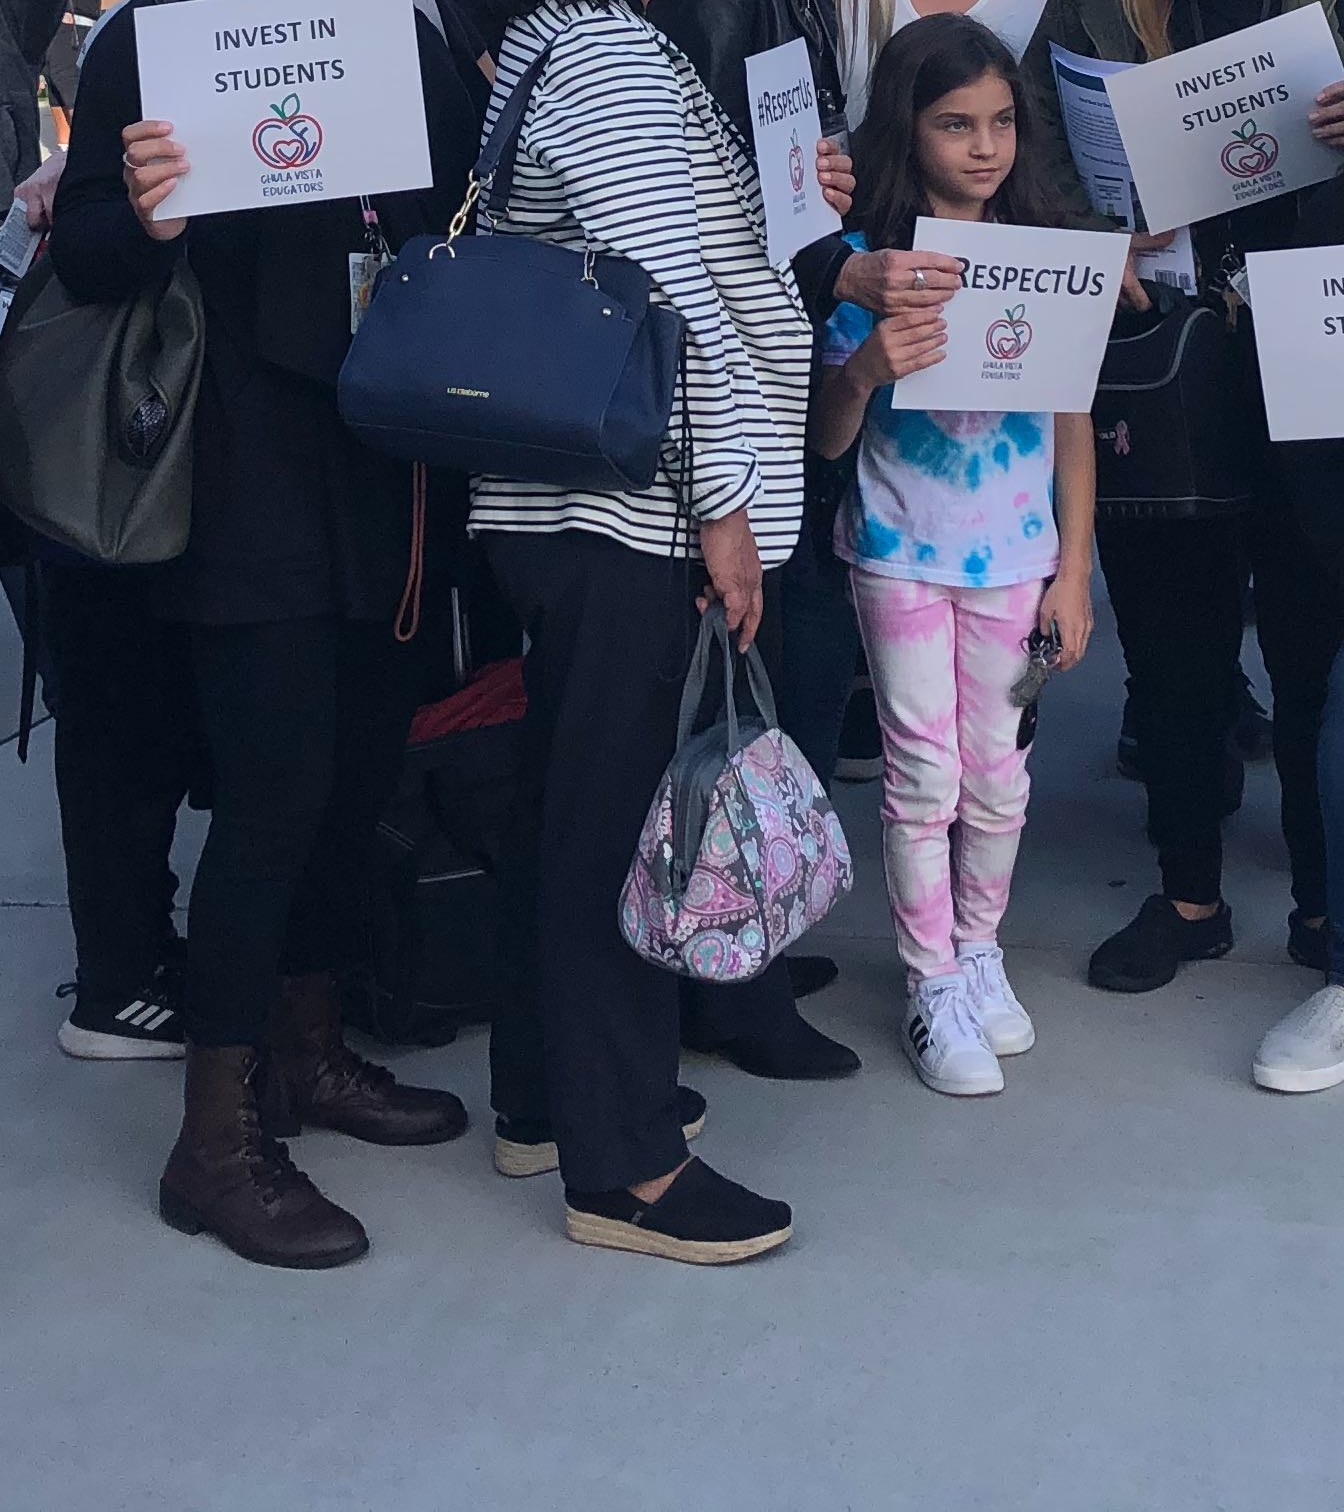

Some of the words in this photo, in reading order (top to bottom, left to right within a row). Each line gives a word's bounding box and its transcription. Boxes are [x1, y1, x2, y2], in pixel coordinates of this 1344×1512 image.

[215, 22, 302, 51] INVEST
[310, 17, 336, 40] IN
[214, 59, 345, 93] STUDENTS
[1175, 60, 1246, 99] INVEST
[1251, 51, 1276, 73] IN
[1182, 84, 1289, 131] STUDENTS
[260, 171, 292, 185] CHULA
[294, 168, 323, 181] VISTA
[262, 181, 324, 197] EDUCATORS
